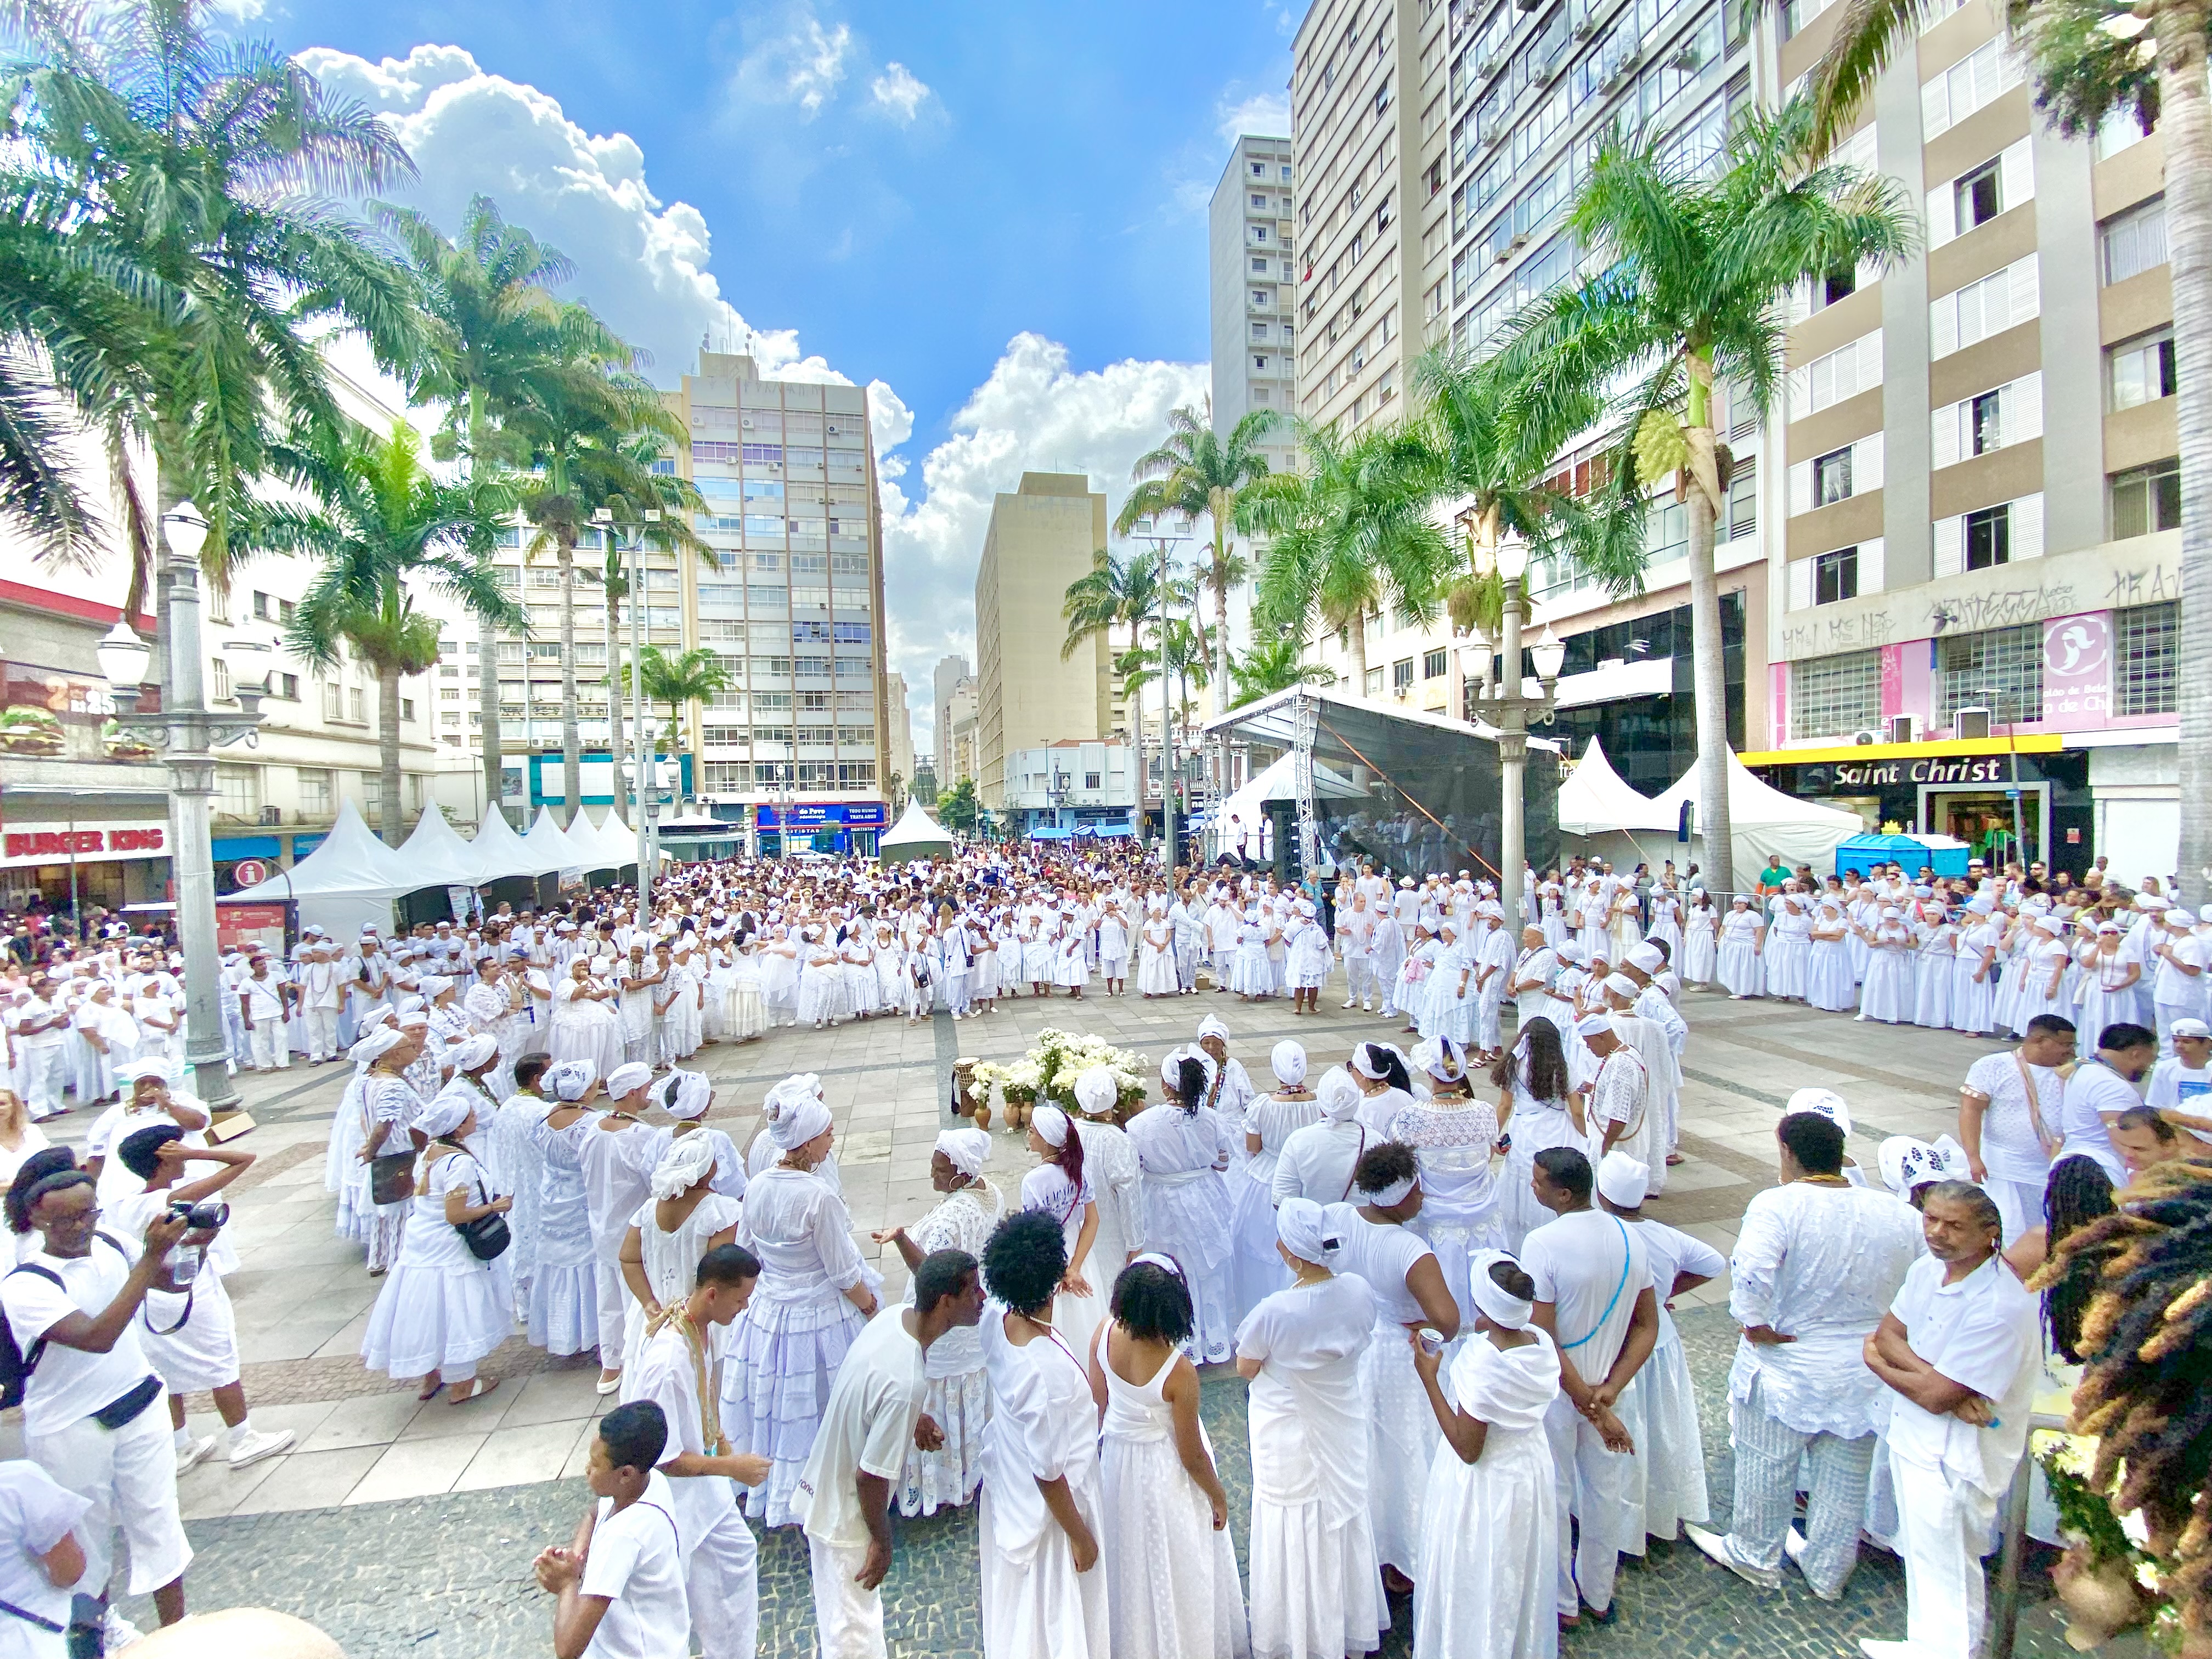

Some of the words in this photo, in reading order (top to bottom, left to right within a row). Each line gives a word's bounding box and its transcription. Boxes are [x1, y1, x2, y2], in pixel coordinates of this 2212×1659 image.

[2068, 686, 2080, 695] de
[2058, 699, 2079, 714] de
[1835, 764, 1900, 785] Saint
[1909, 758, 2000, 782] Christ
[5, 831, 104, 857] BURGER
[109, 828, 163, 851] KING
